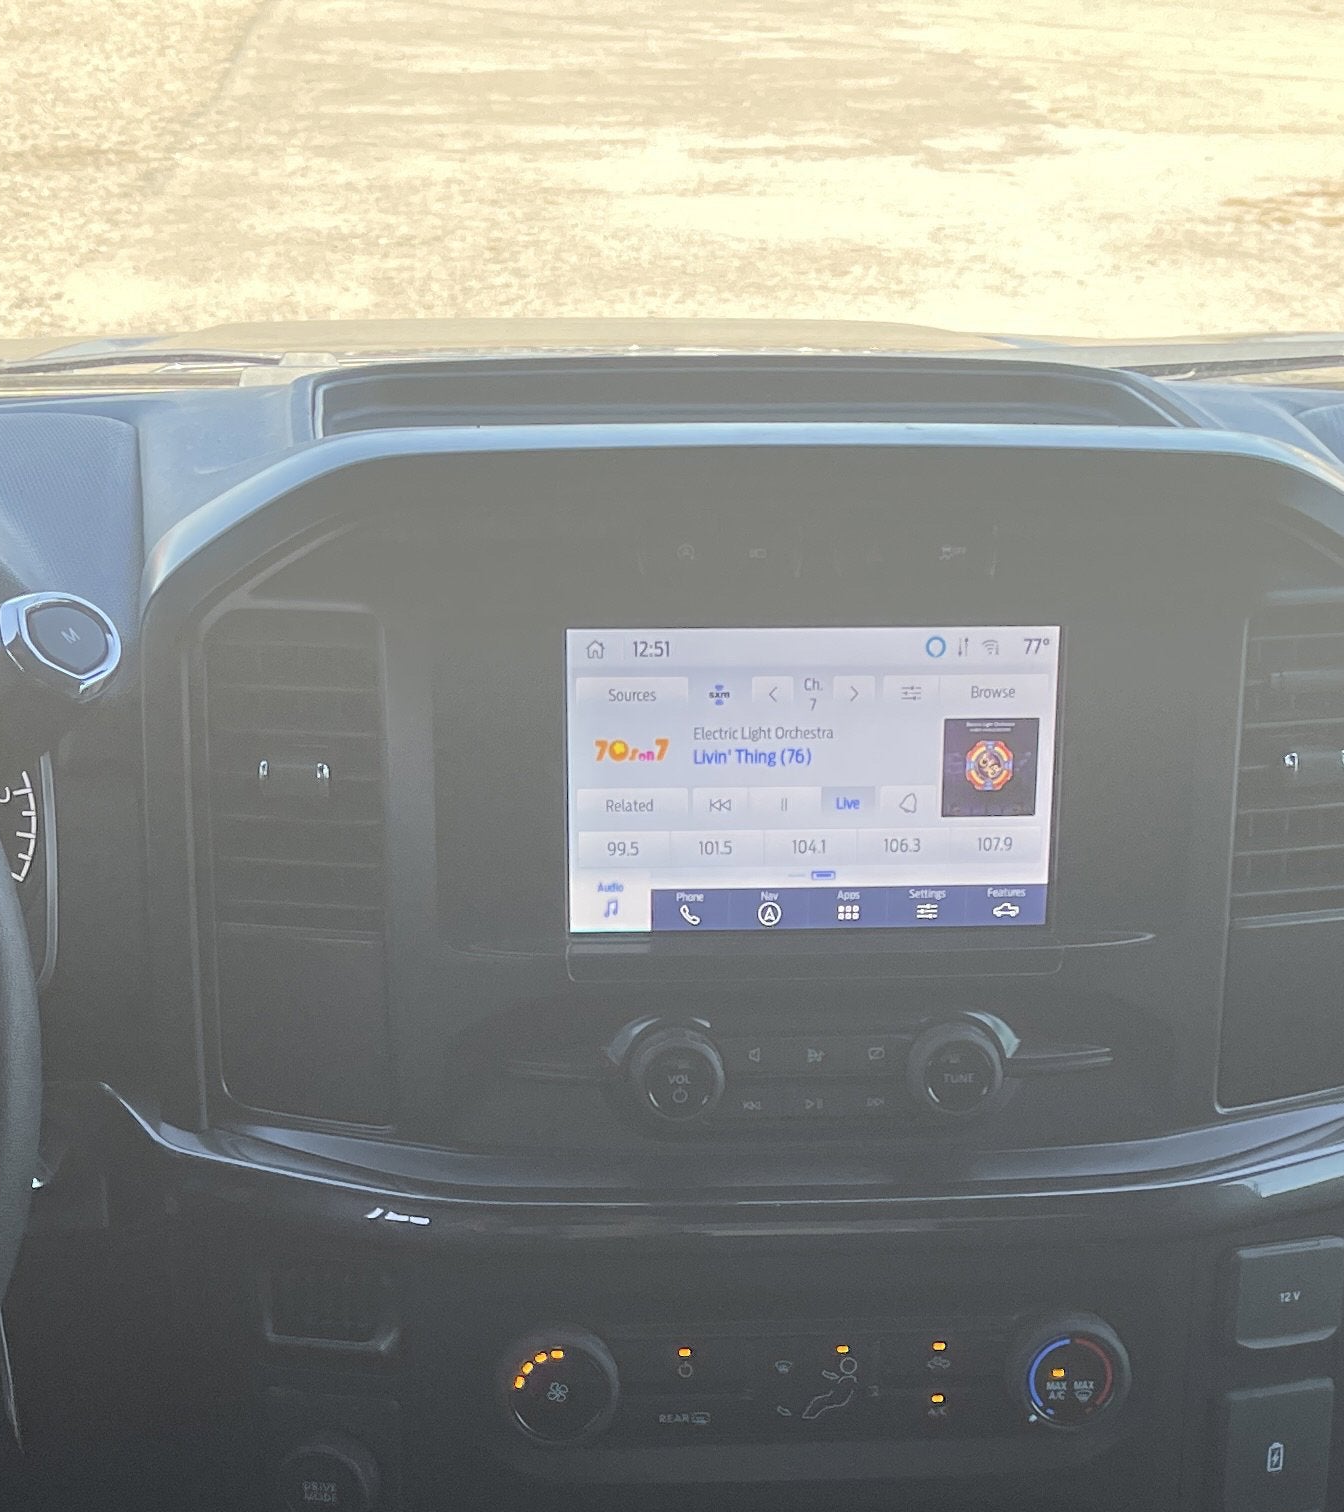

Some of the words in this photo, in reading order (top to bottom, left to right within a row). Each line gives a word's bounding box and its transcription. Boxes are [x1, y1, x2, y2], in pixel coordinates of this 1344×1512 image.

[61, 628, 80, 644] M
[632, 641, 671, 658] 12:51
[804, 678, 823, 692] Ch.
[971, 684, 1016, 700] Browse
[608, 687, 657, 704] Sources
[809, 698, 817, 711] 7
[693, 726, 738, 741] Electric
[741, 726, 771, 744] Light
[774, 726, 834, 741] Orchestra
[693, 748, 732, 766] Livin'
[735, 748, 776, 769] Thing
[780, 748, 812, 767] (76)
[605, 798, 654, 814] Related
[836, 797, 860, 811] Live
[607, 841, 639, 858] 99.5
[698, 840, 733, 856] 101.5
[791, 839, 827, 856] 104.1
[883, 838, 921, 855] 106.3
[977, 837, 1013, 853] 107.9
[597, 882, 624, 894] Audio
[987, 886, 1026, 899] Features
[676, 892, 704, 904] Phone
[760, 891, 779, 902] Nav
[837, 890, 860, 904] Apps
[909, 888, 947, 904] Settings
[667, 1074, 692, 1085] VOL
[943, 1073, 975, 1084] TUNE
[1280, 1292, 1292, 1302] 12
[1293, 1290, 1301, 1301] V
[1046, 1381, 1067, 1390] MAX
[659, 1413, 689, 1424] REAR
